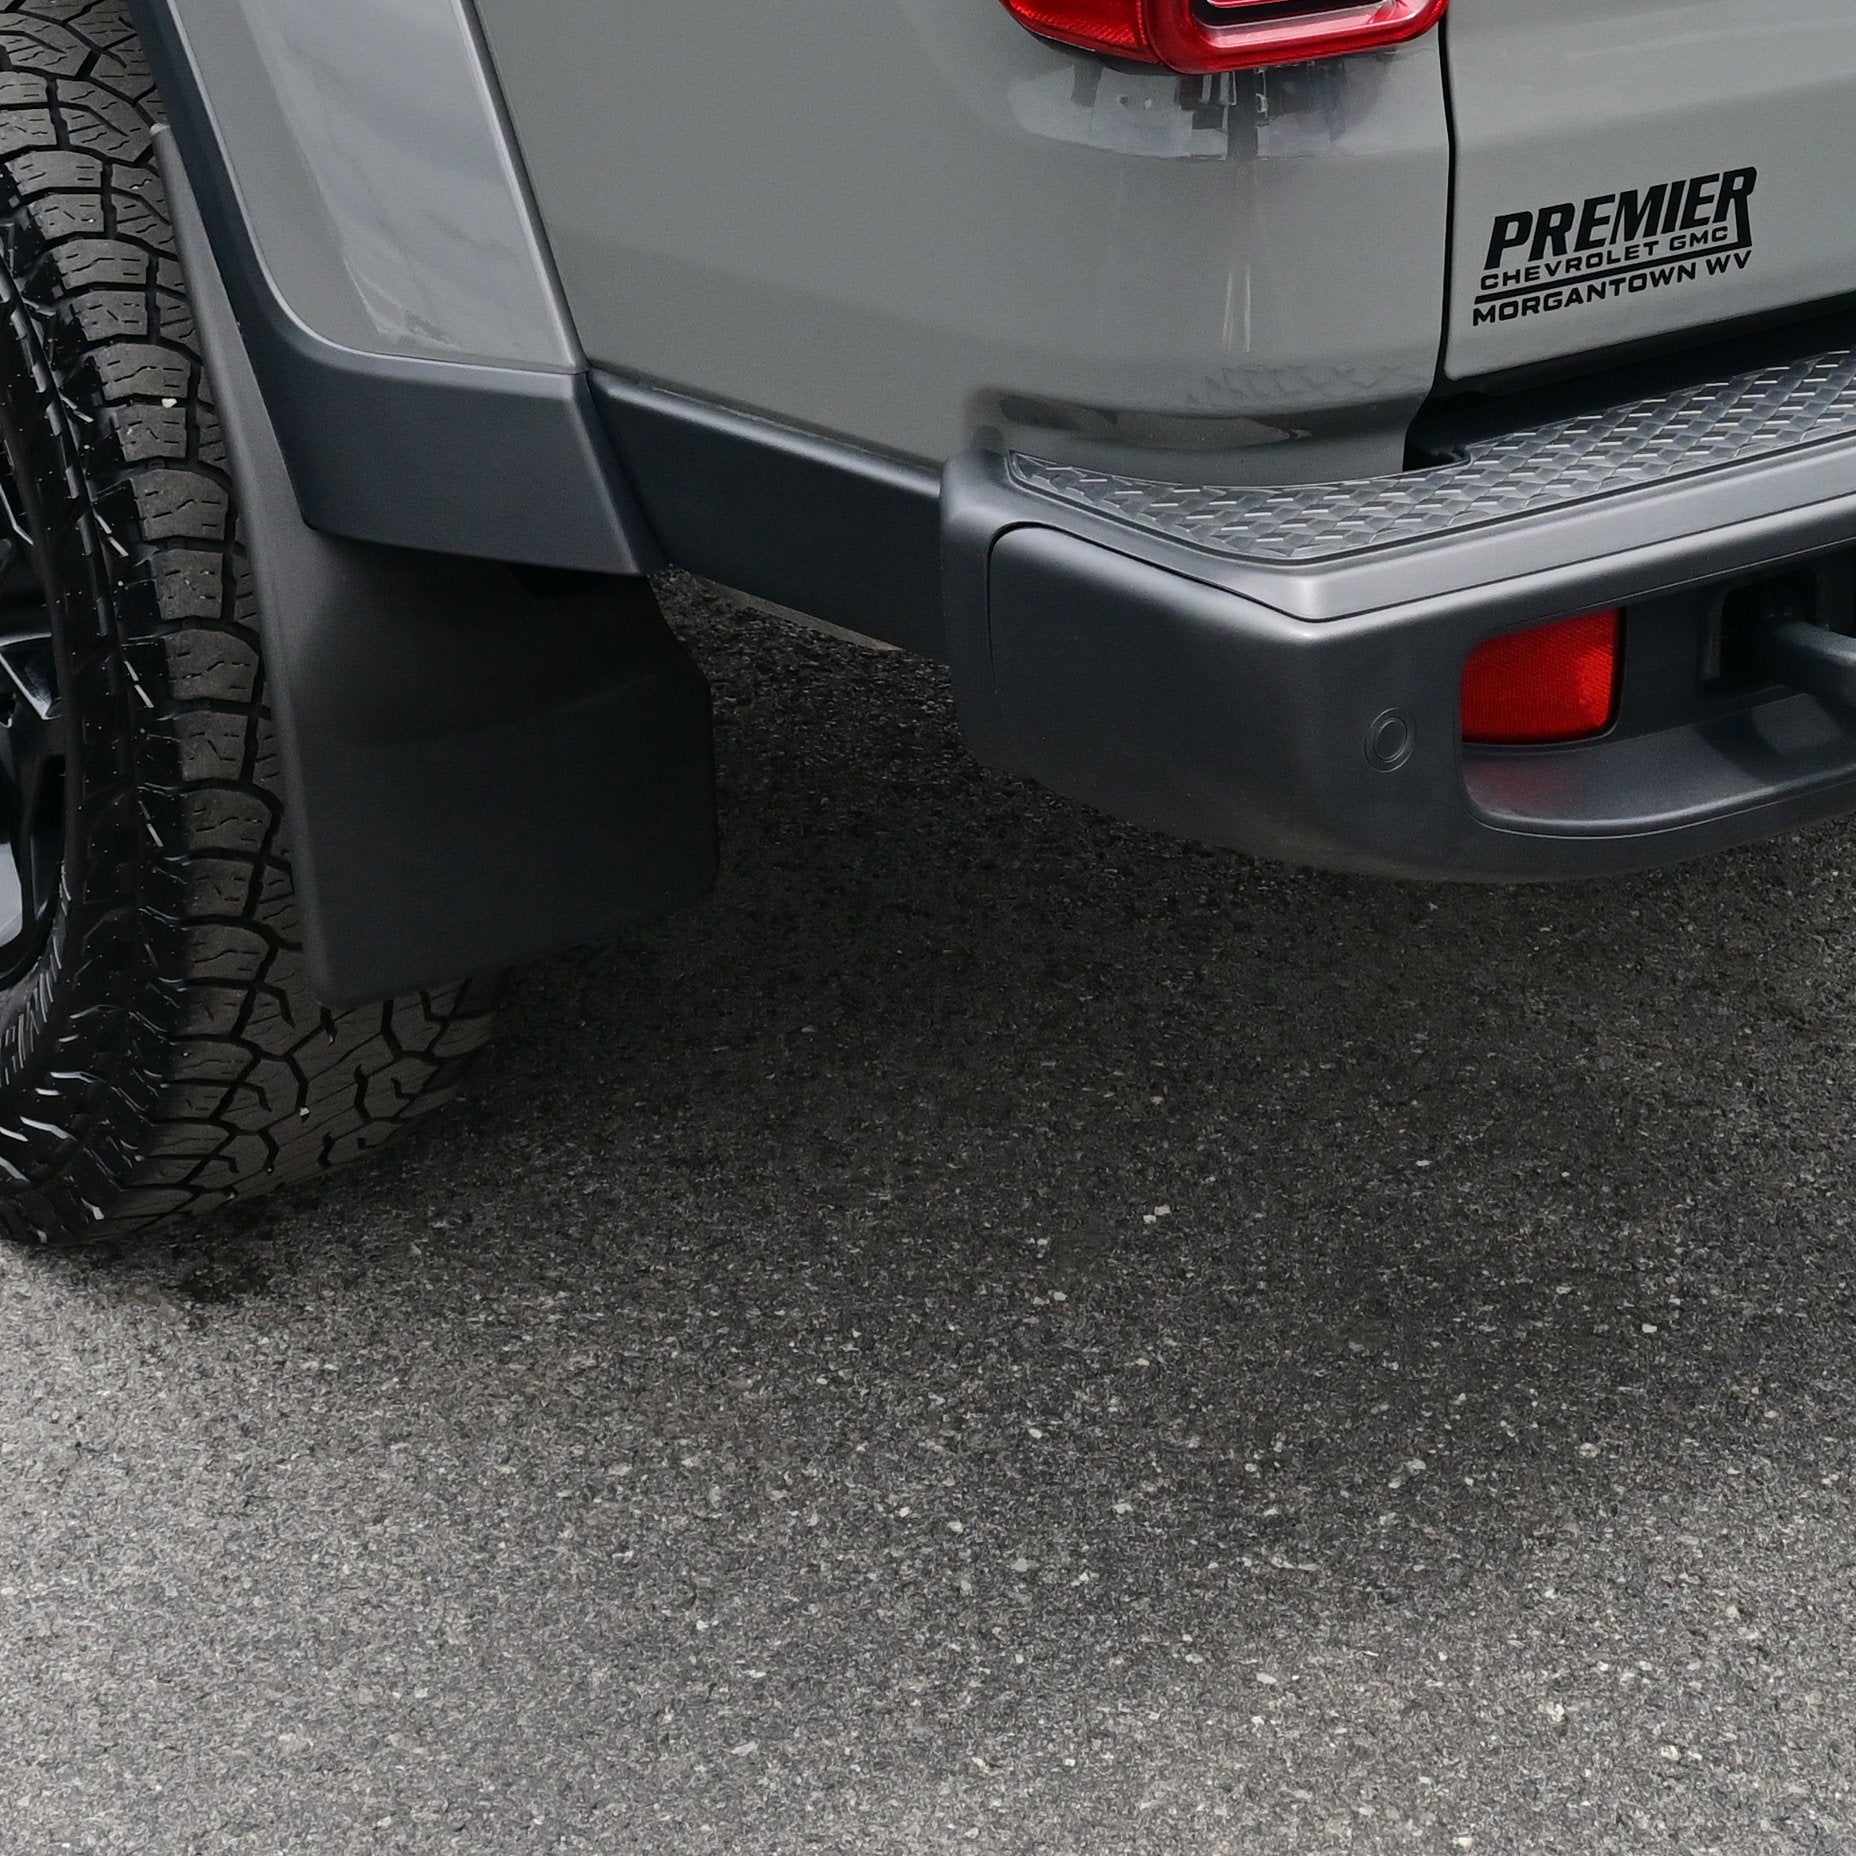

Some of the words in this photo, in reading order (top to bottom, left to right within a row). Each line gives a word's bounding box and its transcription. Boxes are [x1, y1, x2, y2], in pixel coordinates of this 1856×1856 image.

[1484, 166, 1758, 271] PREMIER
[1472, 261, 1697, 327] MORGANTOWN
[1706, 250, 1753, 277] WV
[1480, 241, 1659, 291] CHEVROLET
[1669, 226, 1729, 252] GMC
